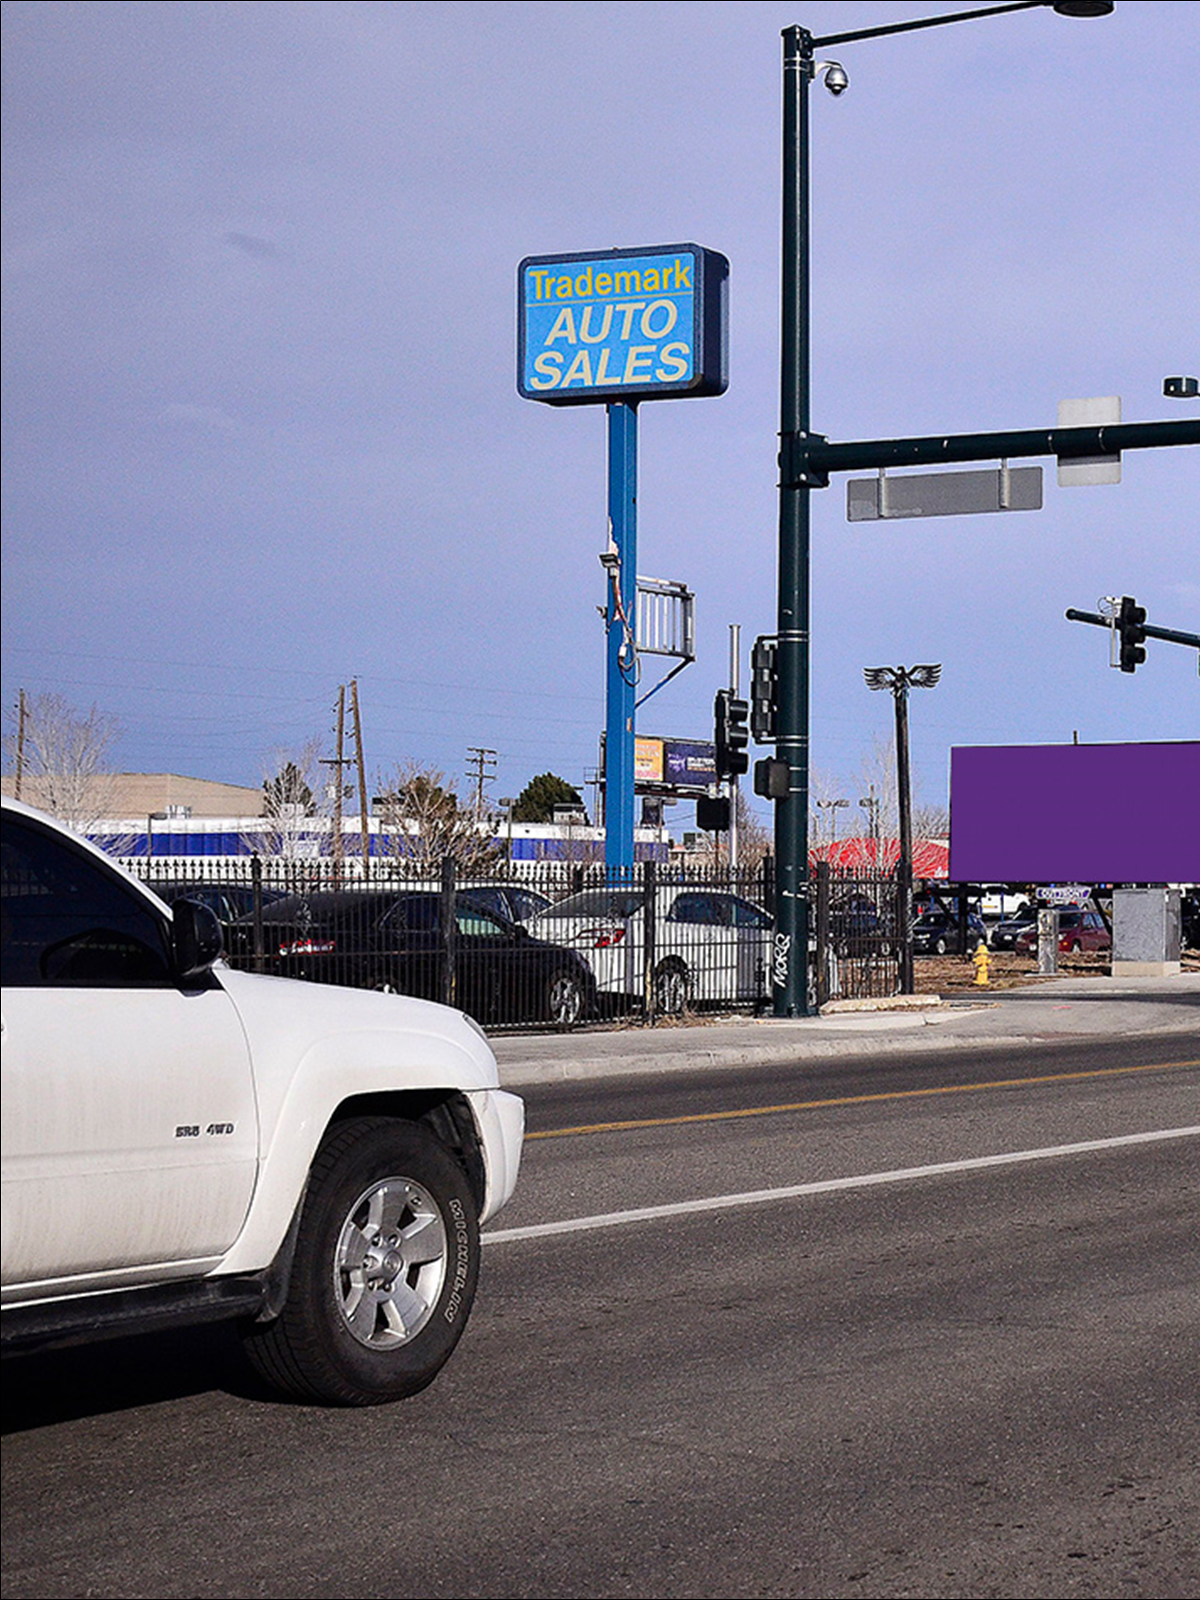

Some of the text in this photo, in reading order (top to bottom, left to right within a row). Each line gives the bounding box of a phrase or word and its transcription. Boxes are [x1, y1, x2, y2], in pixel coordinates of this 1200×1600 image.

[528, 259, 692, 300] Trademark
[544, 299, 678, 346] AUTO
[530, 342, 691, 390] SALES
[206, 1122, 235, 1136] 4WD
[444, 1198, 469, 1323] MICHELIN
